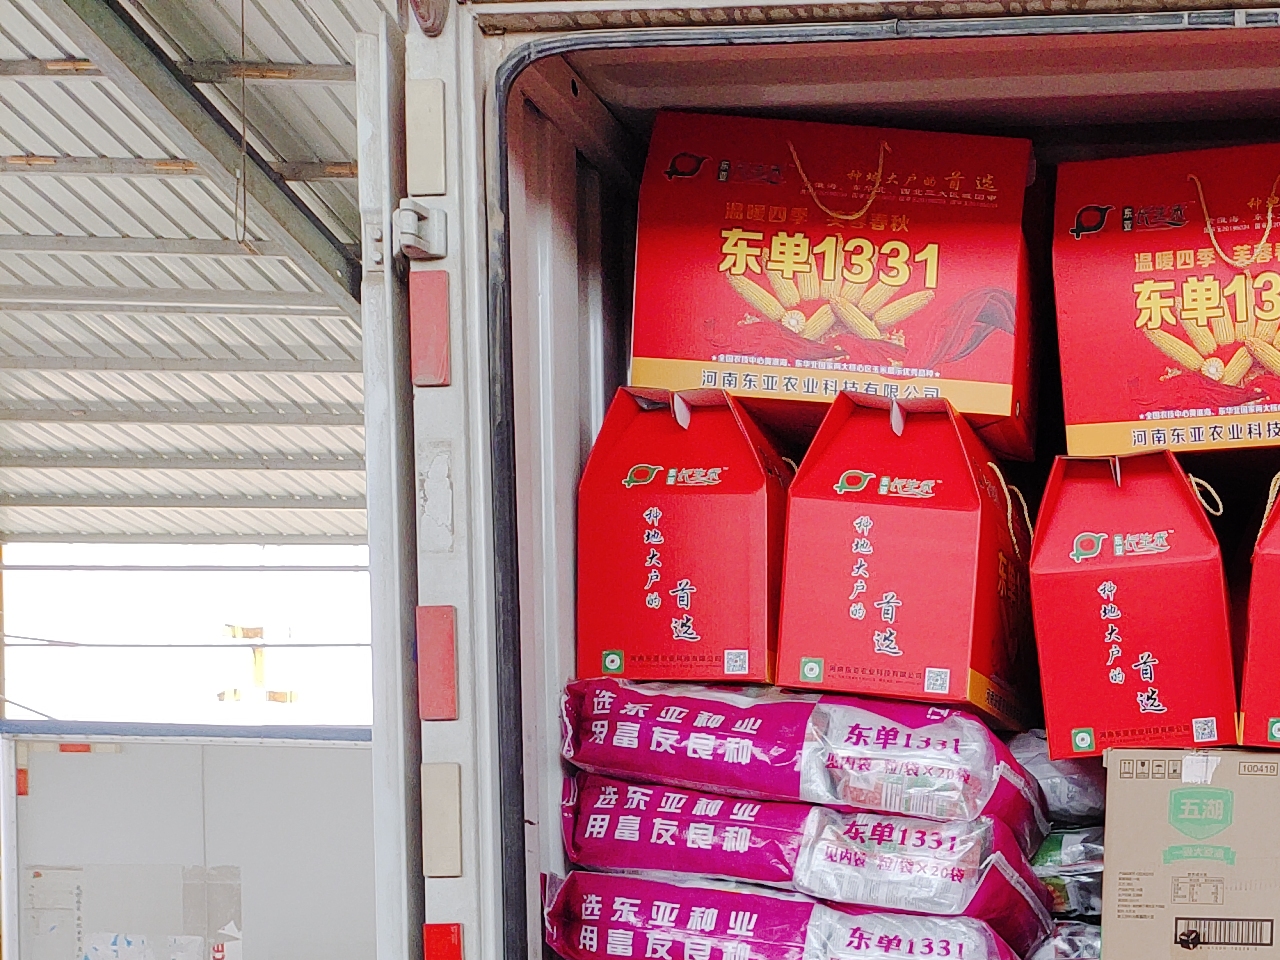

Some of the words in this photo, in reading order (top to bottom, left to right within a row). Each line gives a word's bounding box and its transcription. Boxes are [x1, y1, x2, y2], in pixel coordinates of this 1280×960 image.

[719, 228, 940, 288] 东单1331
[1134, 247, 1216, 272] 温暖四季
[643, 507, 664, 609] 种地大户的
[849, 515, 873, 620] 种地大户的
[669, 579, 701, 641] 首选
[873, 593, 903, 657] 首选
[1097, 581, 1125, 684] 种地大户的
[1132, 652, 1167, 714] 首选
[592, 689, 763, 734] 选东亚种业
[589, 720, 754, 766] 用富友良种
[844, 723, 961, 755] 东单1331
[1242, 764, 1276, 774] 100419
[594, 785, 762, 822] 选东亚种业
[1179, 799, 1224, 820] 五湖
[584, 814, 752, 854] 用富友良种
[843, 820, 957, 854] 东单1331
[581, 893, 759, 937] 选东亚种业
[845, 926, 965, 960] 东单1331
